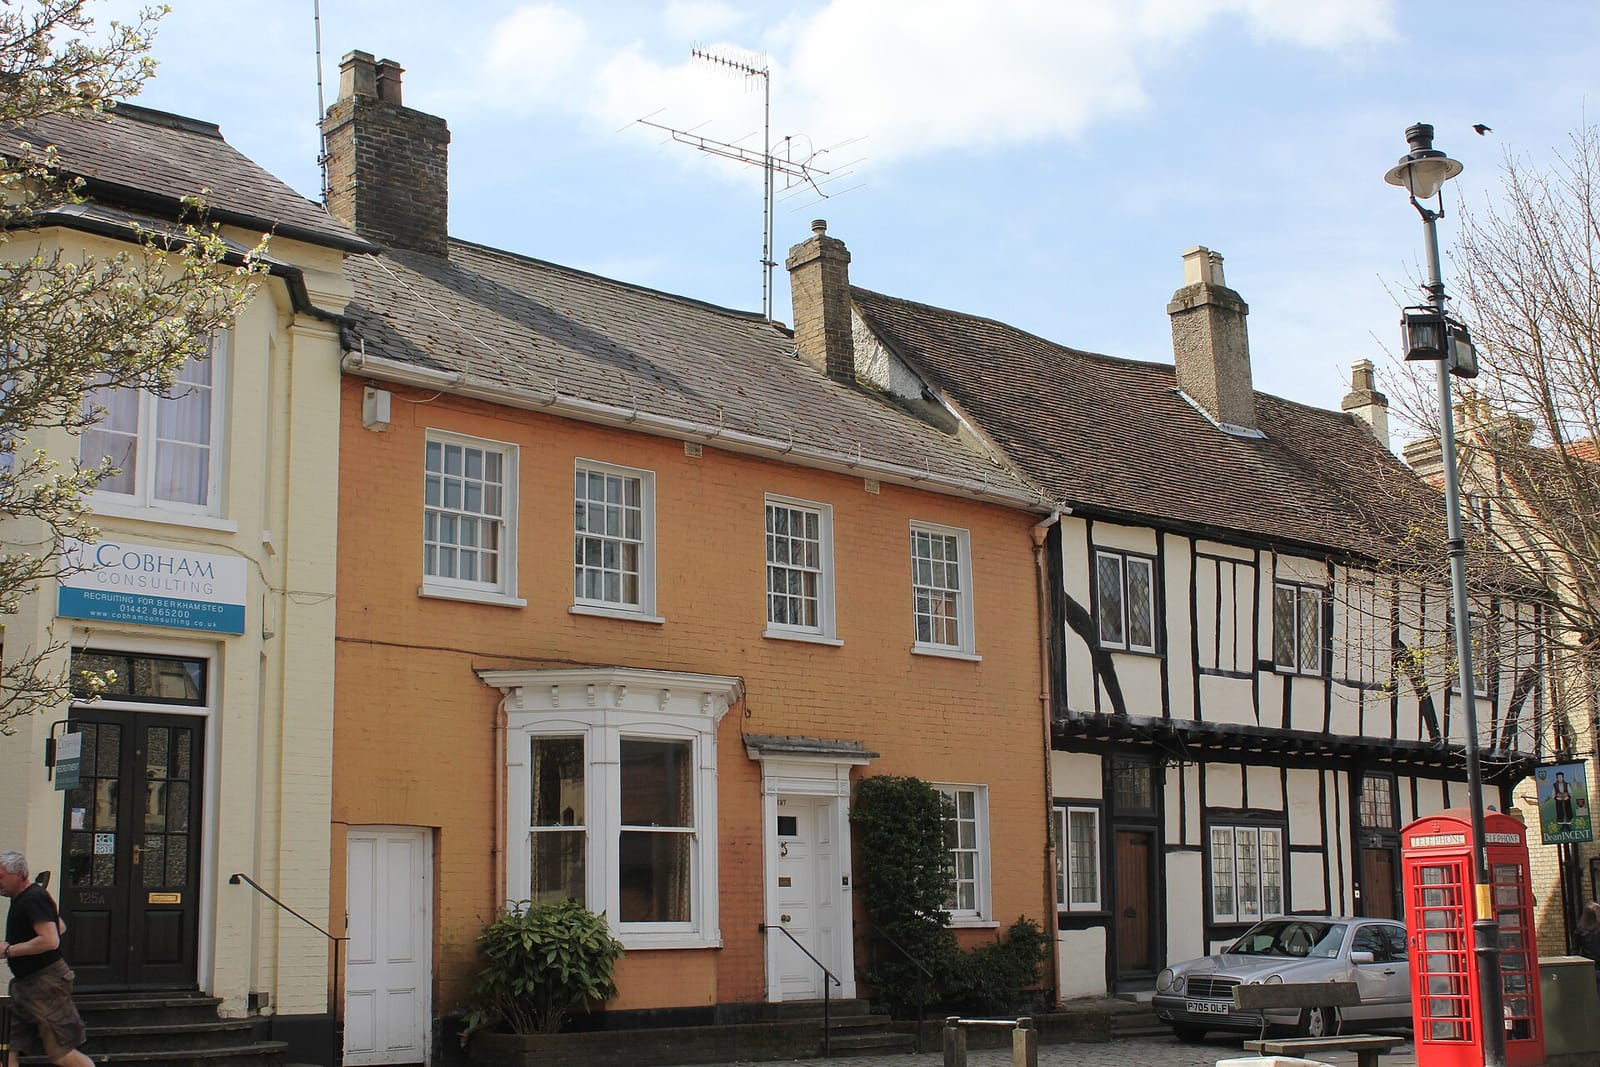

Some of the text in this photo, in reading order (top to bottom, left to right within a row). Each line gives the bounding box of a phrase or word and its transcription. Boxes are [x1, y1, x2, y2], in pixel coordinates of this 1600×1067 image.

[96, 544, 214, 579] COBHAM
[97, 571, 213, 595] CONSULTING
[83, 591, 224, 613] RECRUITING FOR BERKHAMSTED
[119, 604, 190, 618] 01442 865200
[89, 610, 217, 628] www.cobhamconsulting.co.uk
[1413, 835, 1464, 847] TELEPHONE
[1485, 833, 1519, 844] ELEPHONE
[1543, 830, 1590, 842] Dean INCENT
[1188, 1002, 1208, 1012] P705
